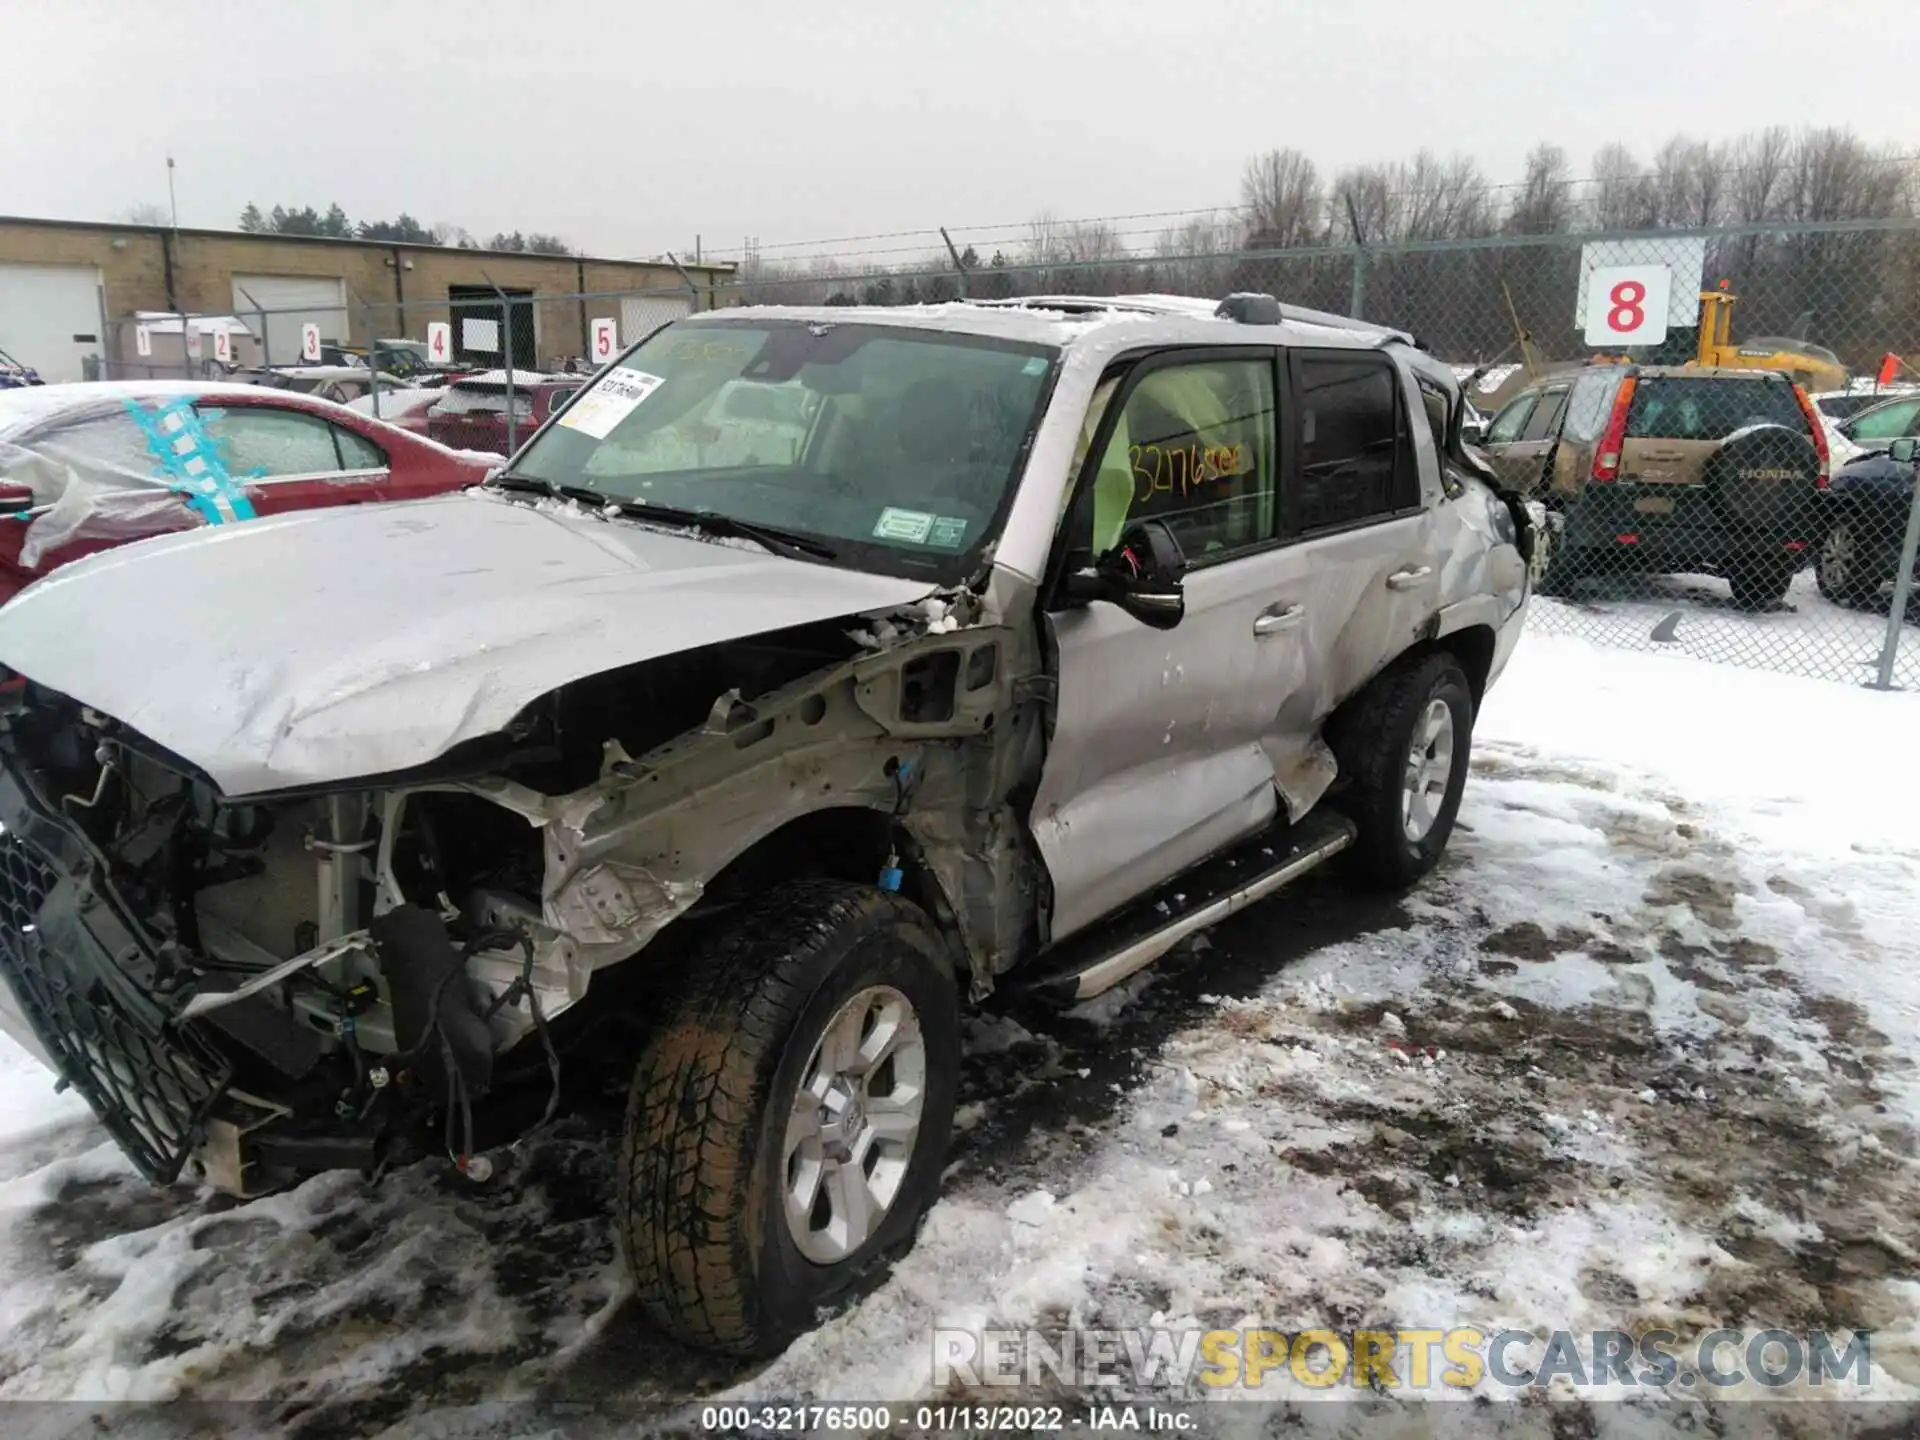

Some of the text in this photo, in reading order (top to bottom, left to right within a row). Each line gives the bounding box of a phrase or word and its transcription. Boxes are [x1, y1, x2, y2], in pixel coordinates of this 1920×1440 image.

[1607, 280, 1646, 333] 8
[139, 329, 147, 350] 1
[218, 334, 226, 355] 2
[308, 330, 316, 354] 3
[434, 330, 444, 356] 4
[598, 327, 610, 356] 5
[1739, 468, 1804, 479] HONDA
